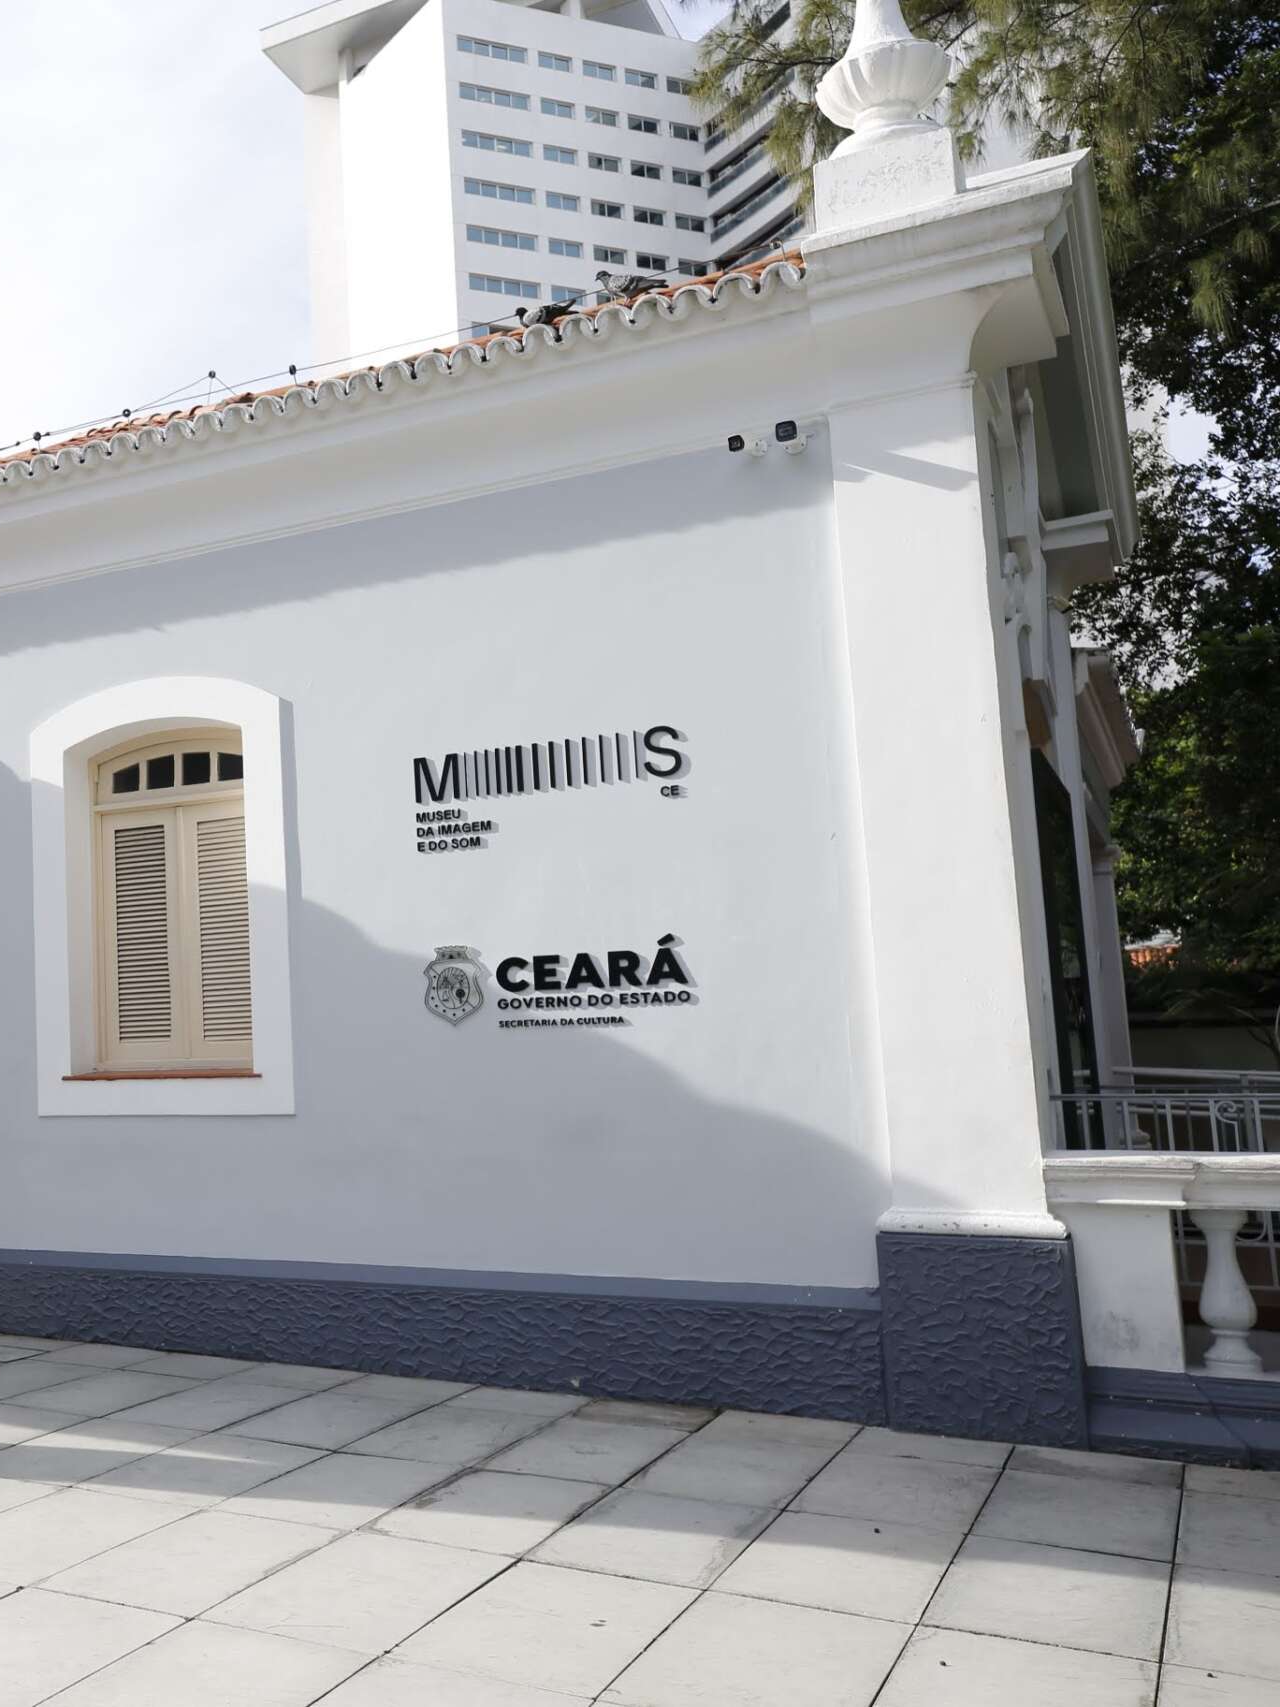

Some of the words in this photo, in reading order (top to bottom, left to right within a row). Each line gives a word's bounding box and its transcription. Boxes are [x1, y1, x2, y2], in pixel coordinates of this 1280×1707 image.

[660, 785, 680, 798] CE
[416, 808, 462, 823] MUSEU
[416, 825, 435, 838] DA
[437, 820, 492, 836] IMAGEM
[417, 841, 426, 852] E
[428, 839, 448, 851] DO
[451, 836, 481, 850] SOM
[495, 933, 689, 993] CEARÁ
[497, 994, 582, 1010] GOVERNO
[587, 993, 613, 1008] DO
[619, 990, 691, 1006] ESTADO
[498, 1018, 558, 1029] SECRETARIA
[560, 1017, 575, 1027] DA
[576, 1016, 625, 1026] CULTURA
